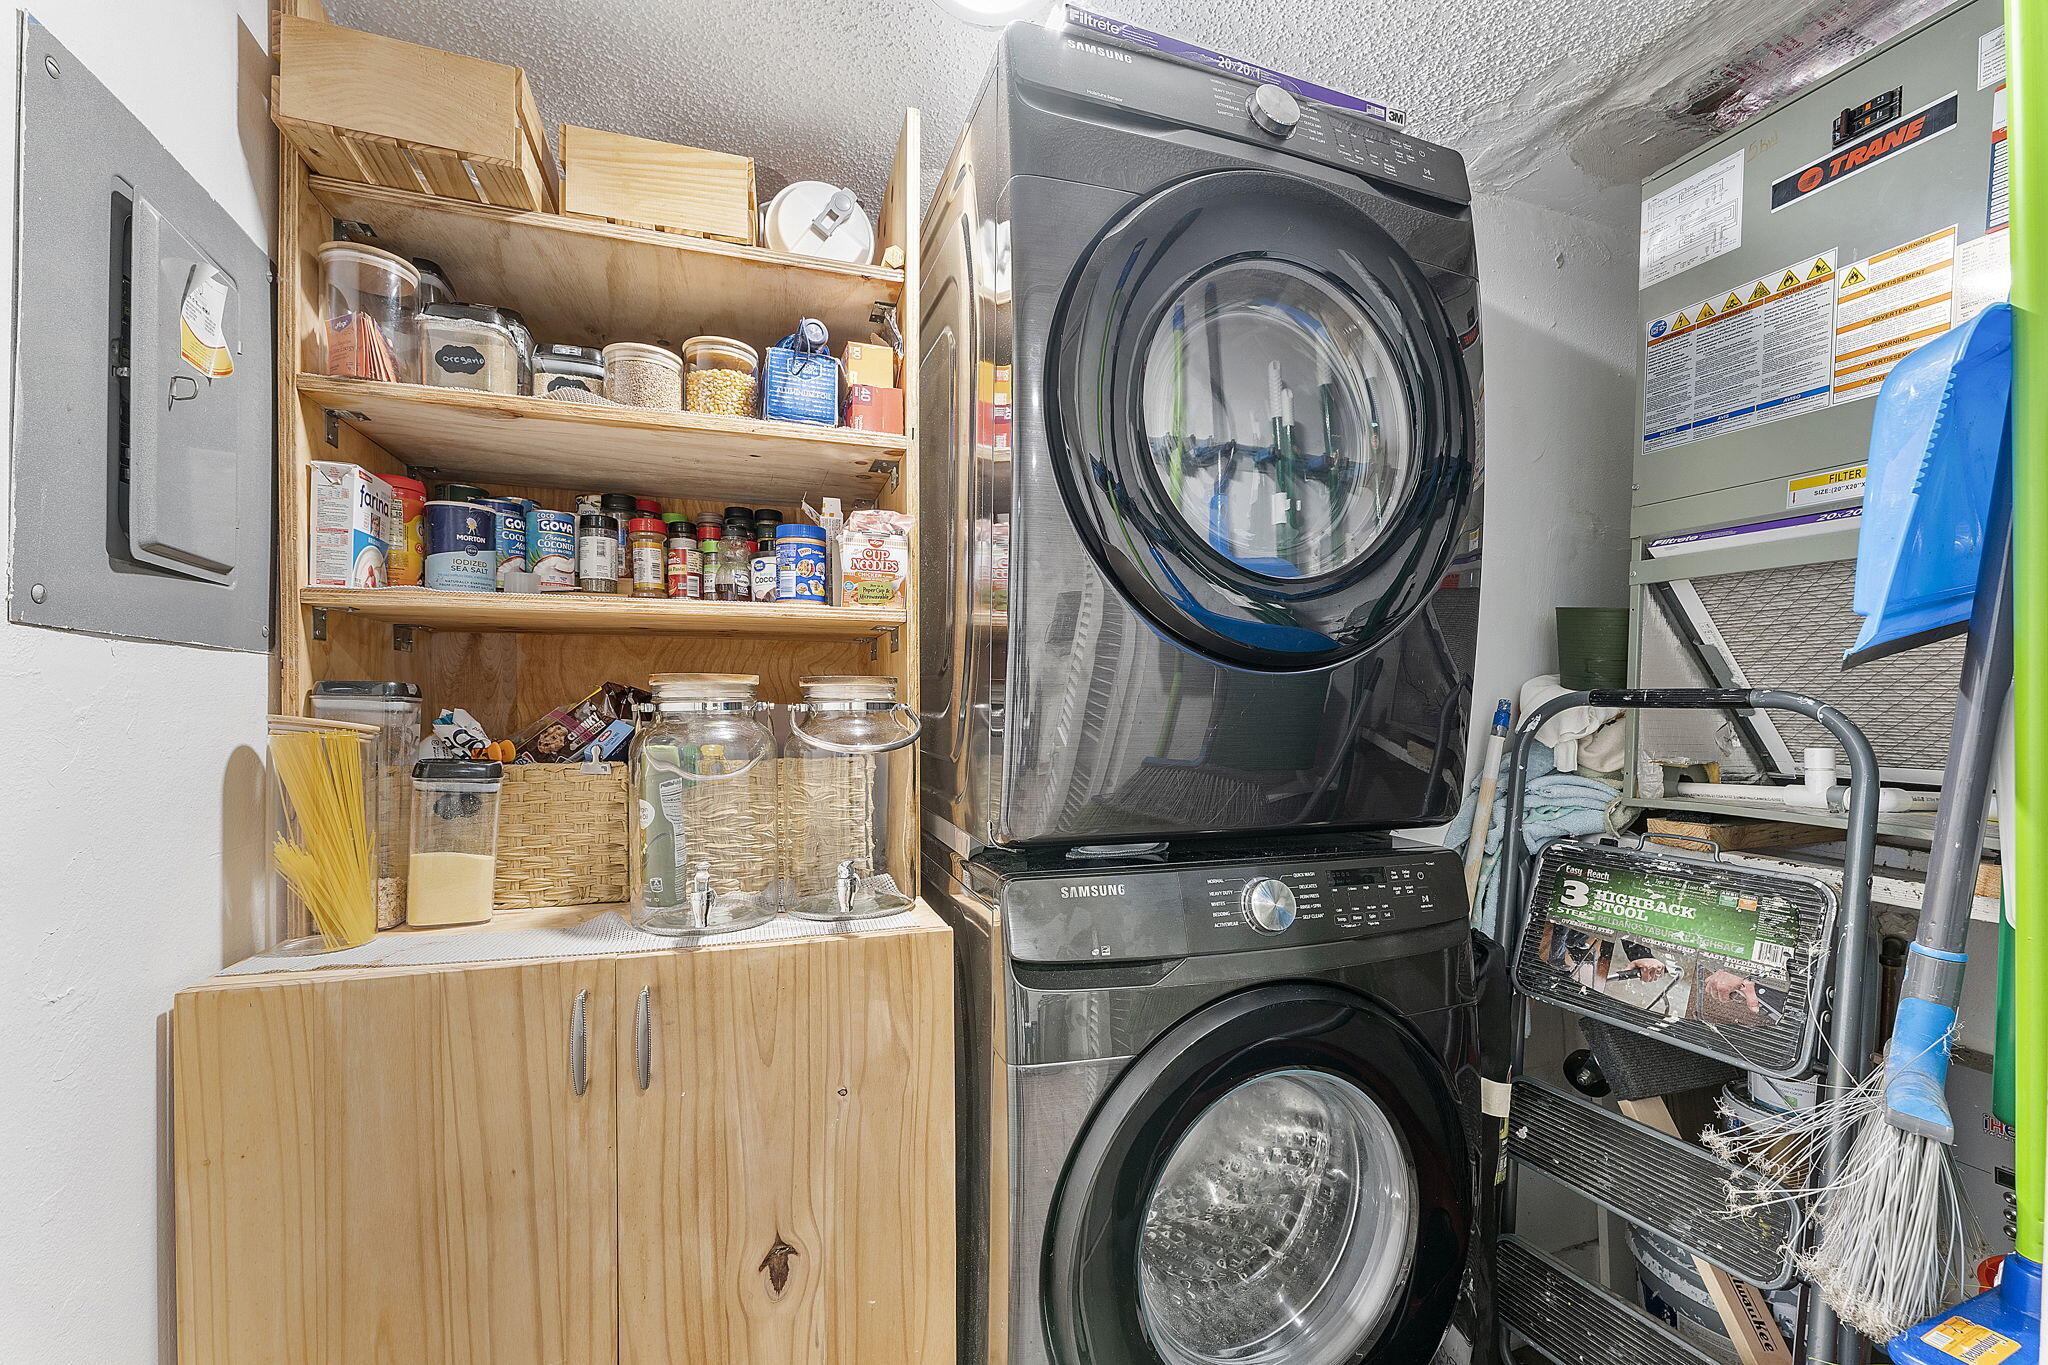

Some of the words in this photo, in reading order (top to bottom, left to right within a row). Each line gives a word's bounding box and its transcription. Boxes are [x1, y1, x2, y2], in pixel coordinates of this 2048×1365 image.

[1069, 9, 1122, 35] Filtrete
[1067, 39, 1133, 64] SAMSUNG
[1218, 55, 1261, 79] 20x20x1
[1388, 110, 1404, 125] 3M
[1829, 116, 1927, 178] TRANE
[1897, 236, 1931, 254] WARNING
[1868, 269, 1926, 293] AVERTISSEMENT
[1871, 303, 1920, 323] ADVERTENCIA
[1877, 336, 1910, 349] WARNING
[442, 355, 484, 366] oregano
[860, 387, 872, 402] 40
[1782, 394, 1802, 404] AVISO
[1716, 413, 1730, 422] AVIS
[1828, 468, 1862, 484] FILTER
[359, 484, 389, 518] farina
[540, 520, 574, 534] GOYA
[456, 533, 486, 544] MORTON
[537, 538, 575, 552] COCONUT
[1651, 534, 1700, 547] Filtrete
[862, 547, 890, 560] CUP
[450, 565, 468, 573] SEA
[470, 566, 488, 575] SALT
[453, 558, 488, 567] IODIZED
[850, 557, 899, 573] NOODLES
[1566, 864, 1583, 876] Easy
[1586, 869, 1610, 881] Reach
[1060, 884, 1126, 900] SAMSUNG
[1560, 879, 1590, 908] 3
[1592, 900, 1649, 922] STOOL
[1593, 888, 1697, 920] HIGHBACK
[1597, 926, 1615, 935] STEP
[1641, 936, 1676, 951] COMFORT
[1676, 944, 1696, 955] GRIP
[1982, 1112, 2016, 1138] iHe
